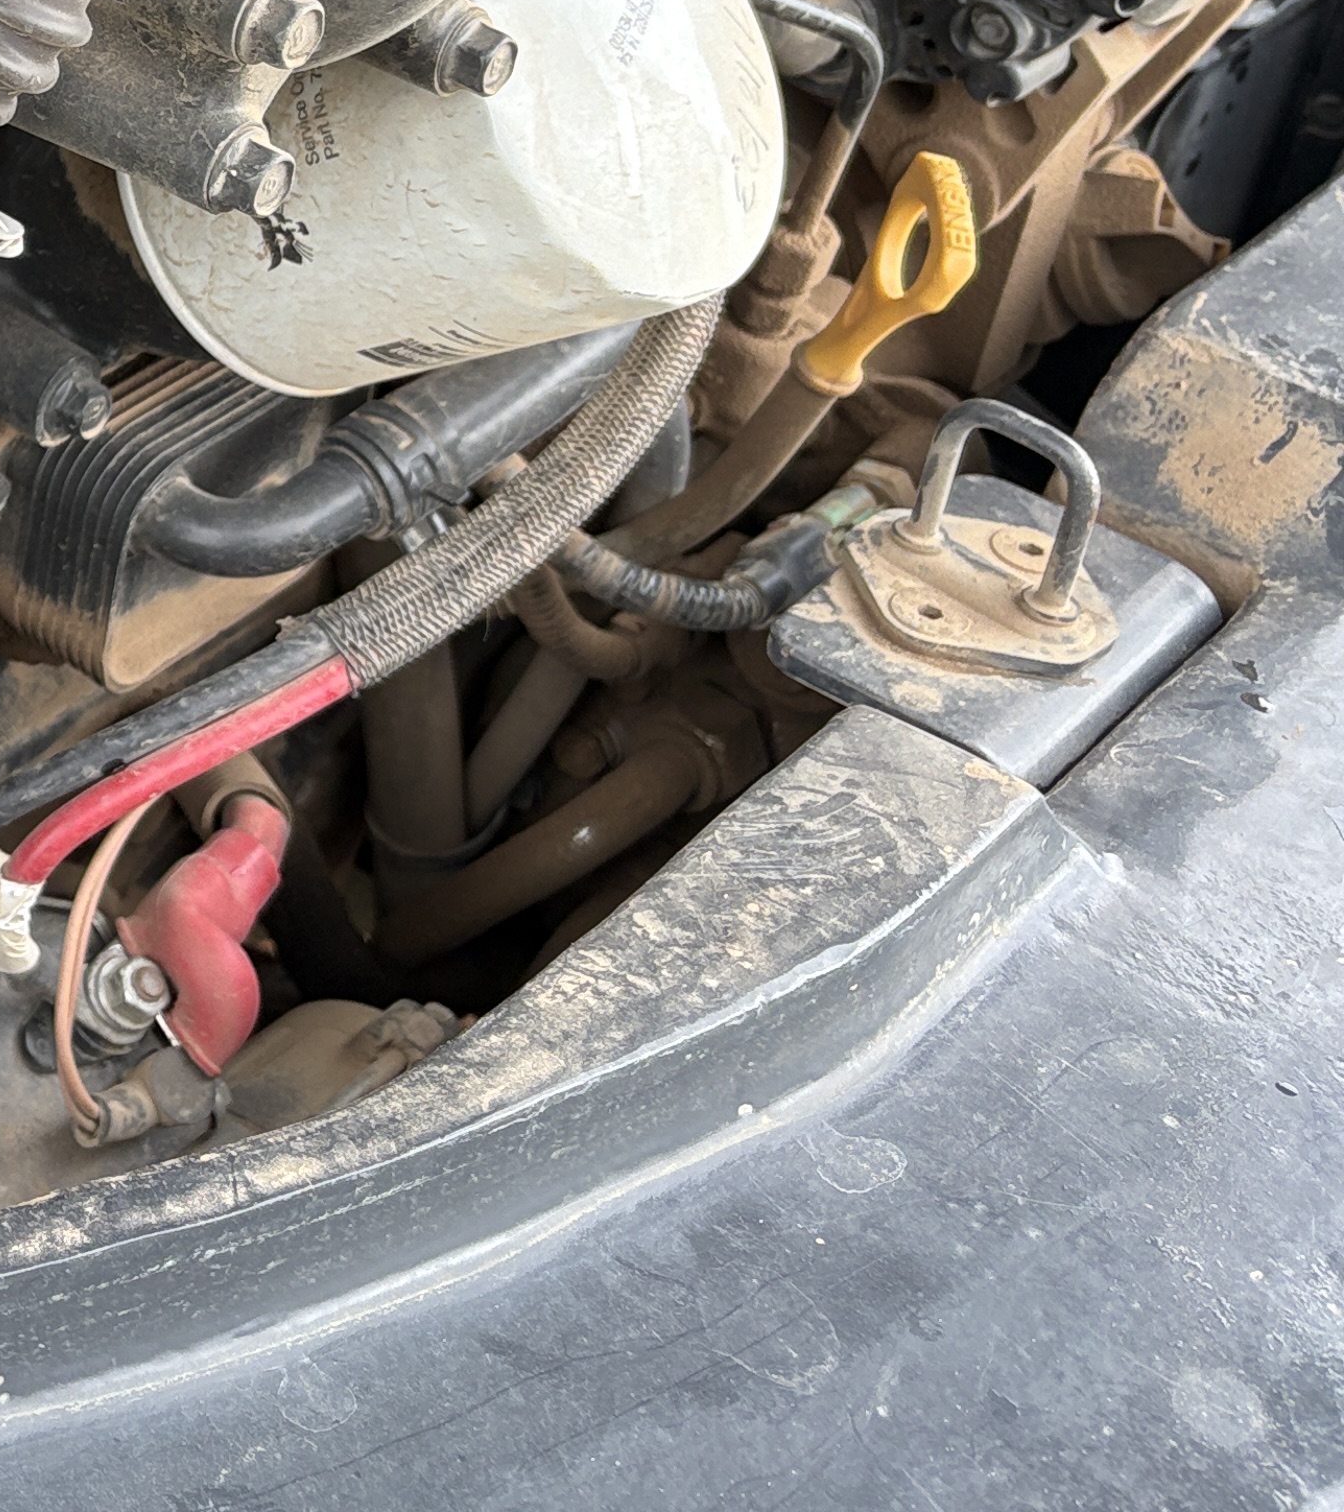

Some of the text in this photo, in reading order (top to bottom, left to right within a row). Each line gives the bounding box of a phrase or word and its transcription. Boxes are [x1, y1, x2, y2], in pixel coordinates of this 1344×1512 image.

[314, 86, 328, 119] No.
[296, 101, 320, 165] Service
[317, 120, 339, 160] Part
